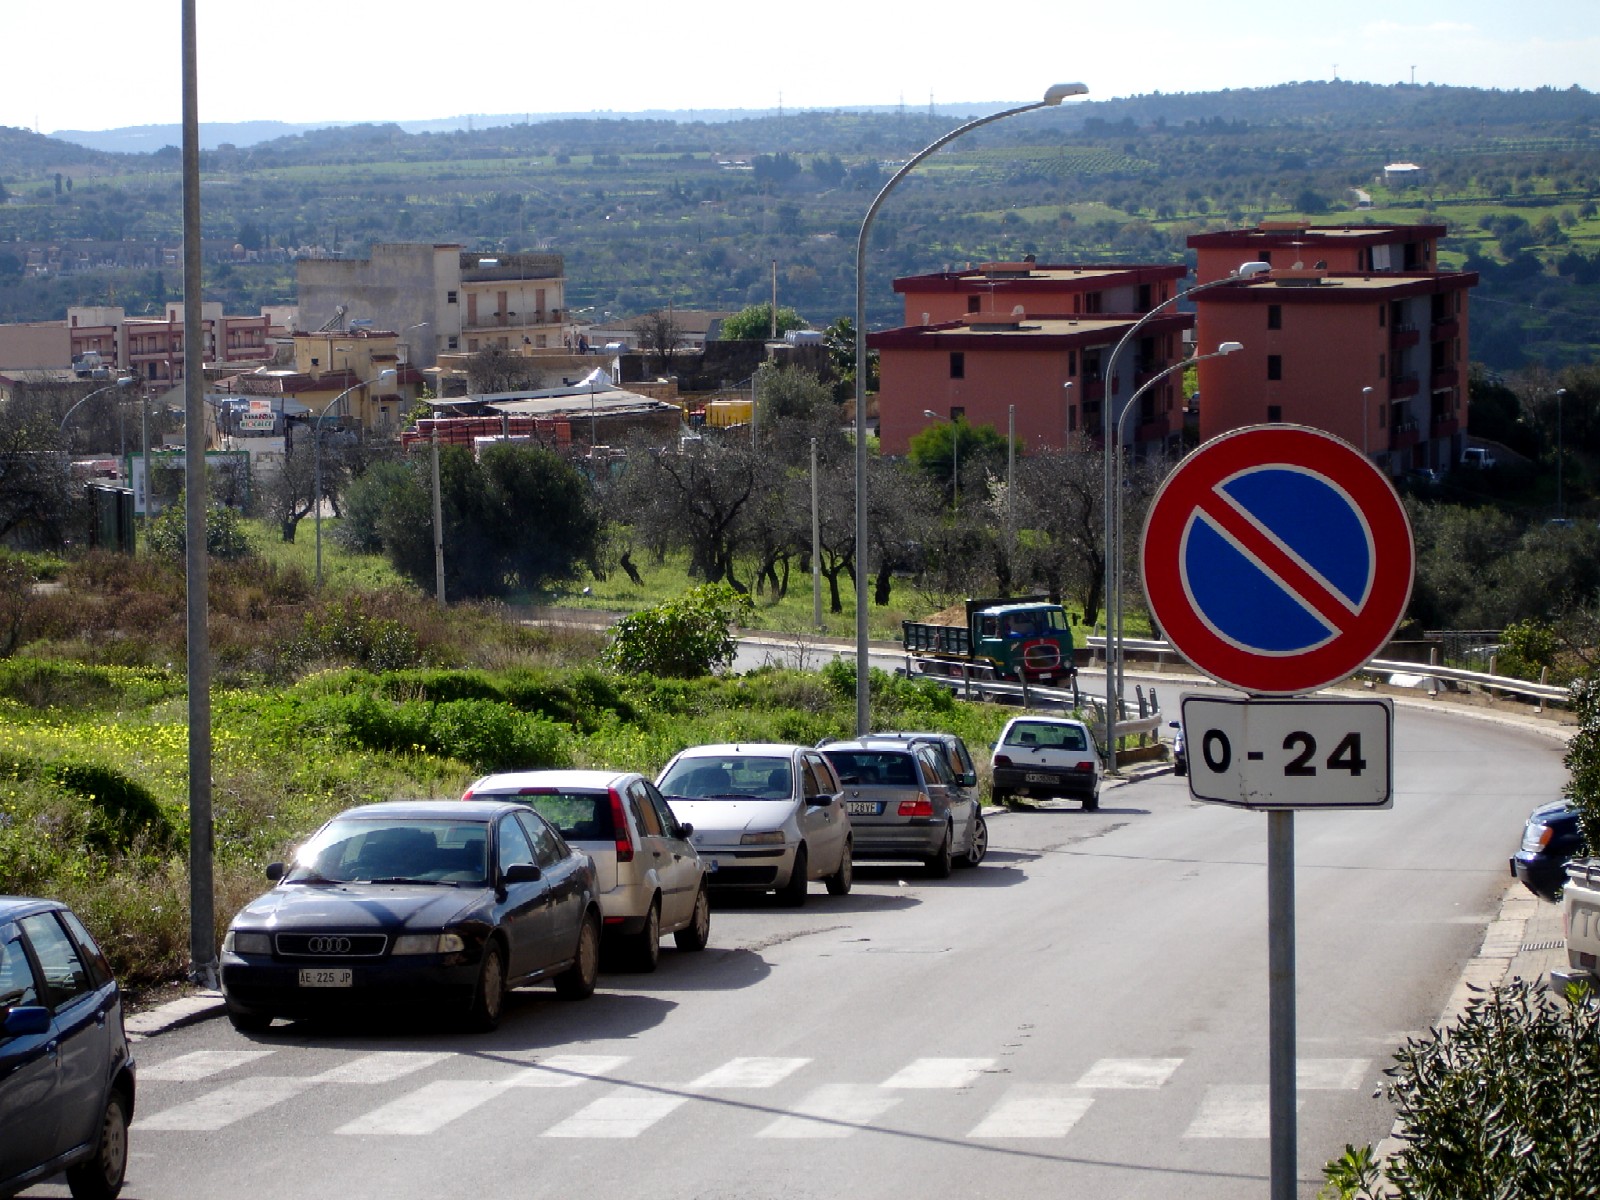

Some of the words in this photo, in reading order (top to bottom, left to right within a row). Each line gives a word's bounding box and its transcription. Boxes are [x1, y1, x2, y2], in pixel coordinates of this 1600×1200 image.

[300, 972, 312, 983] AE
[316, 972, 335, 983] 225
[339, 972, 351, 983] JP
